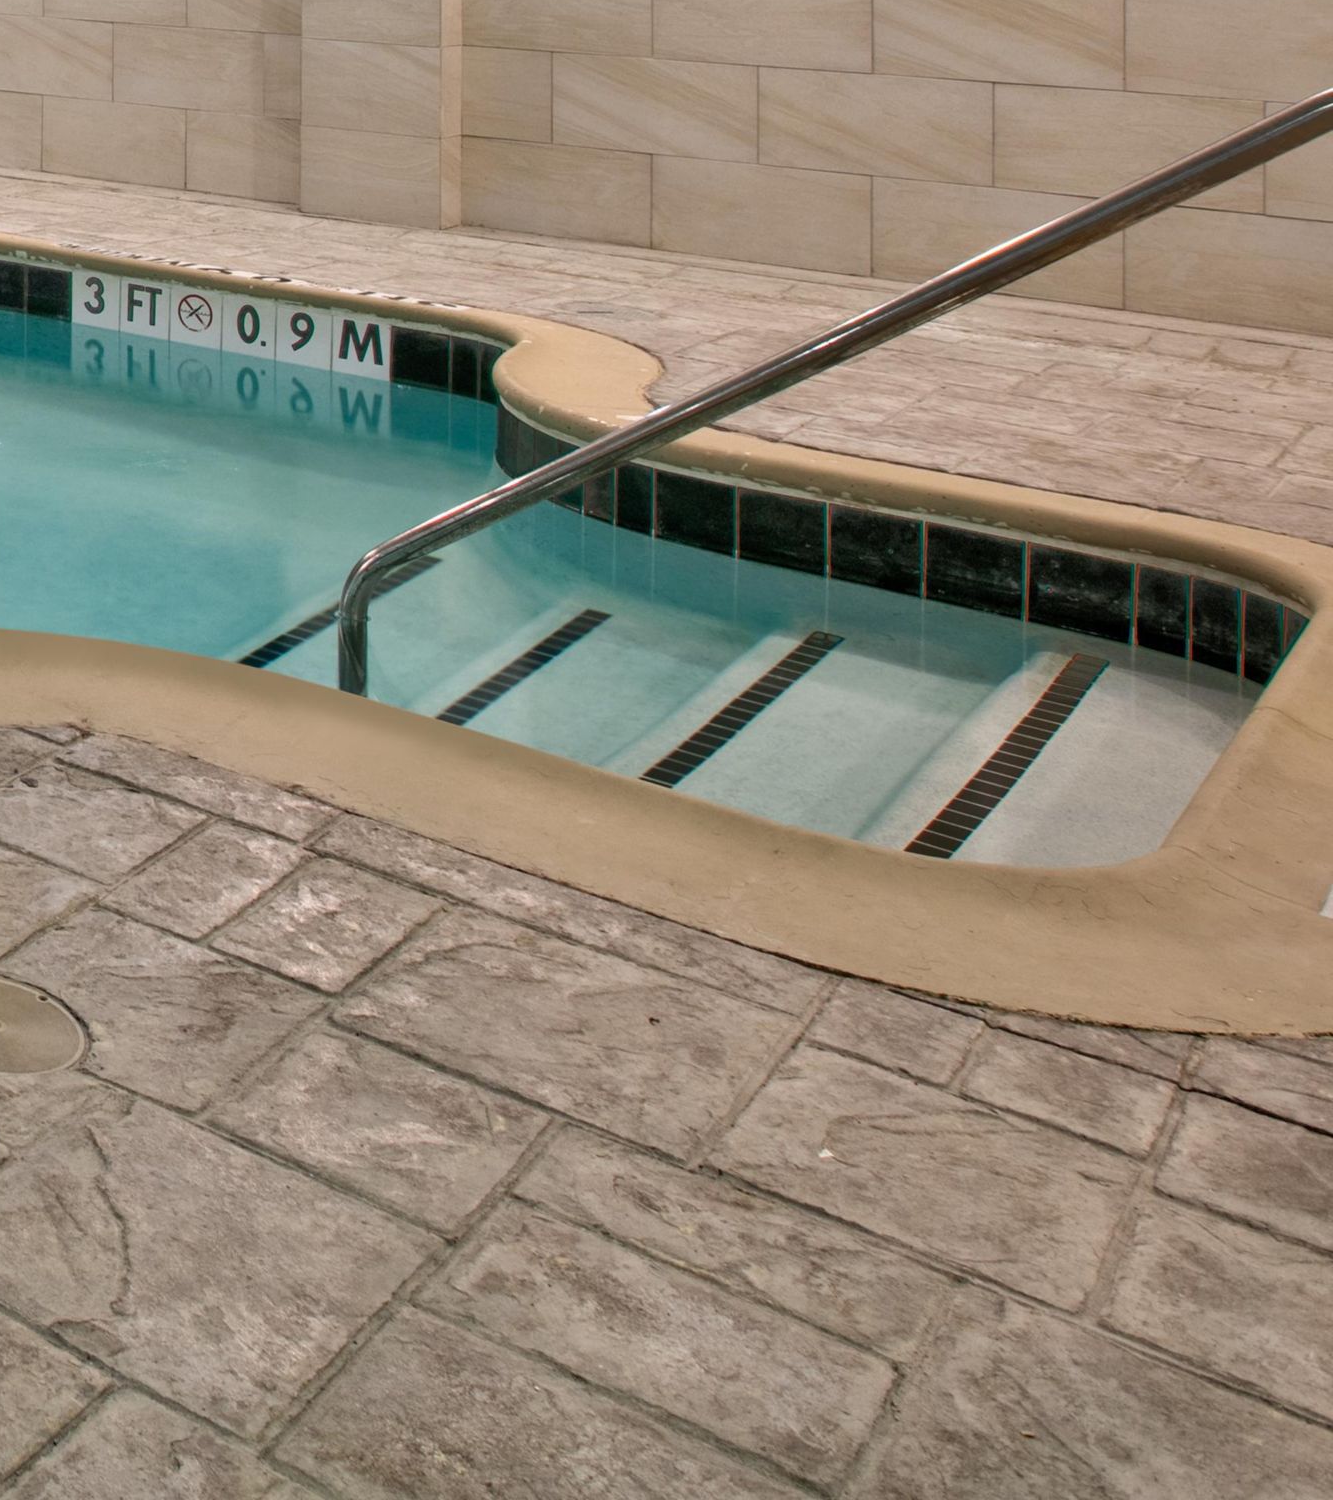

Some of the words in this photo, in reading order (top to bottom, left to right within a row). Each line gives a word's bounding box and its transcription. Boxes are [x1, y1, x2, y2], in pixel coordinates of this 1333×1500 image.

[84, 276, 105, 315] 3
[127, 283, 162, 326] FT
[338, 318, 383, 366] M
